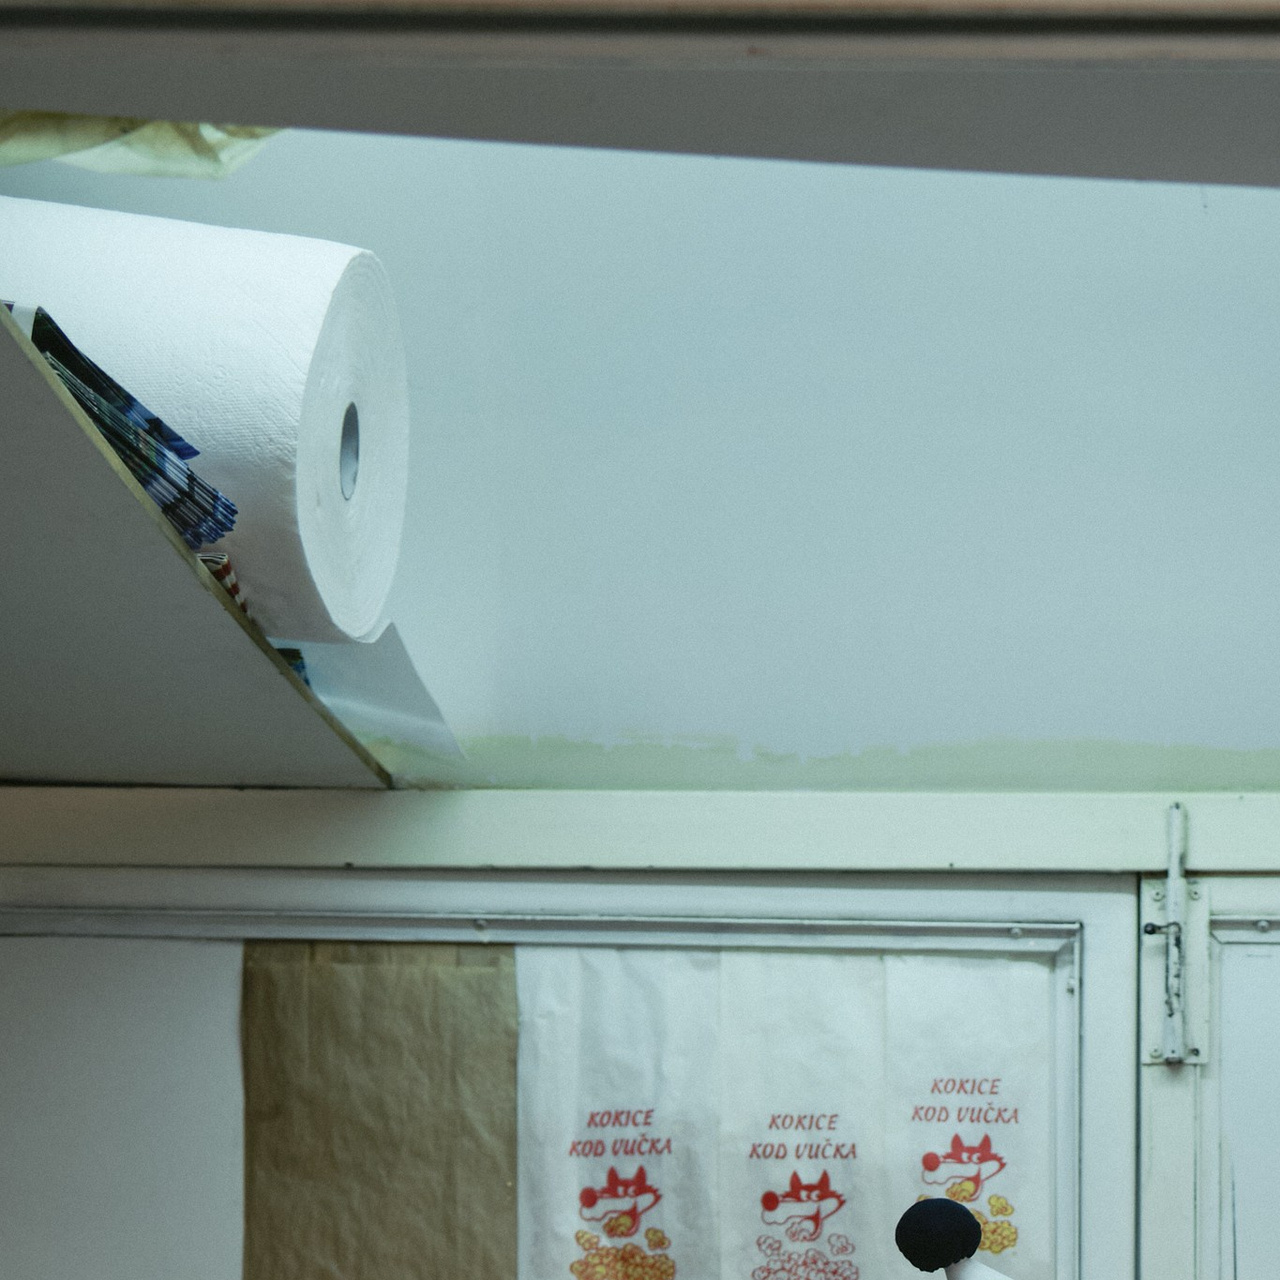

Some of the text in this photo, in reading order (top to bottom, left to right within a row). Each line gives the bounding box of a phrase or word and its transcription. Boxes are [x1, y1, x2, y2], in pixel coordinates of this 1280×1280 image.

[930, 1078, 1002, 1095] KOKICE
[586, 1108, 655, 1128] KOKICE
[768, 1113, 839, 1131] KOKICE
[911, 1101, 1020, 1124] KOD VUČKA
[568, 1133, 673, 1158] KOD VUČKA
[749, 1138, 858, 1160] KOD VUČKA
